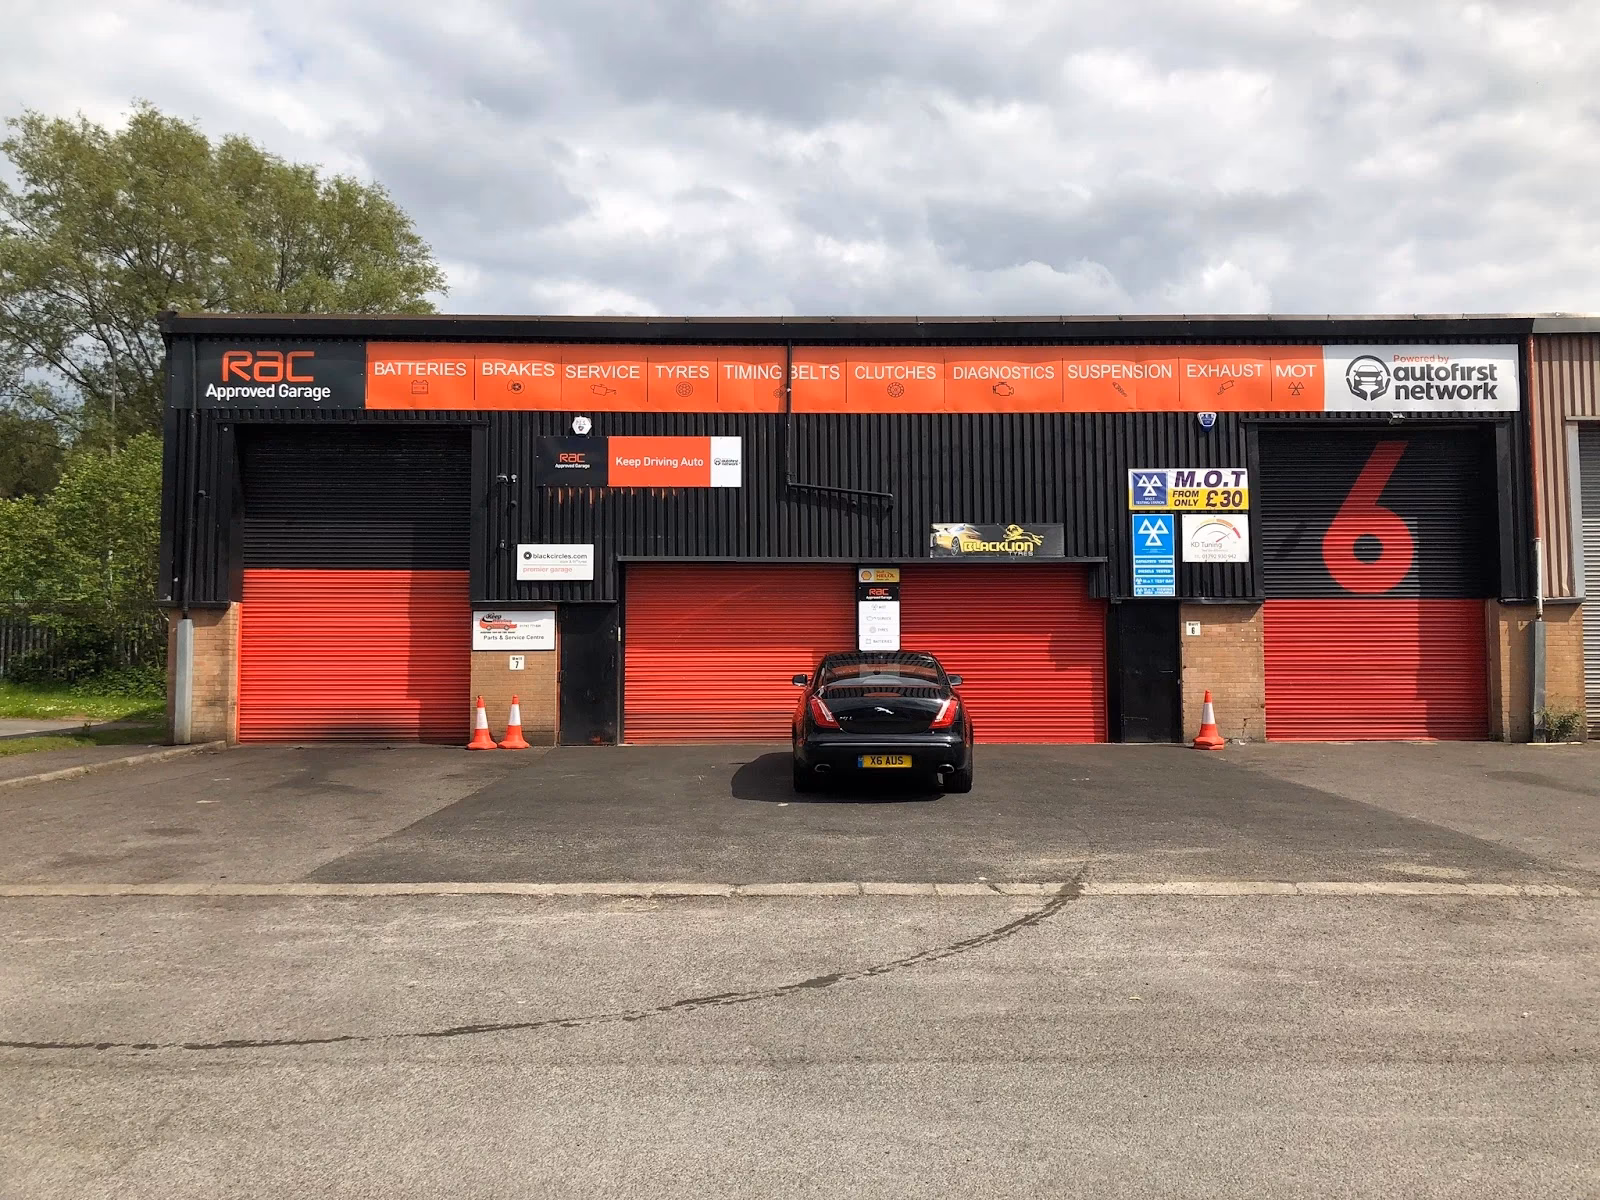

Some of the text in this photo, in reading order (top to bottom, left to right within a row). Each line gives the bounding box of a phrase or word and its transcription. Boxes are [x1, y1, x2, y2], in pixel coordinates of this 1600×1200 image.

[1393, 354, 1450, 364] Powered by
[374, 362, 467, 377] BATTERIES
[482, 362, 556, 377] BRAKES
[565, 364, 641, 379] SERVICE
[655, 365, 710, 379] TYRES
[724, 364, 841, 380] TIMING BELTS
[854, 365, 937, 380] CLUTCHES
[953, 366, 1055, 380] DIAGNOSTICS
[1067, 364, 1172, 379] SUSPENSION
[1186, 363, 1264, 378] EXHAUST
[1276, 364, 1317, 378] MOT
[1393, 363, 1498, 382] autofirst
[205, 384, 331, 401] Approved Garage
[1395, 382, 1498, 400] network
[616, 457, 704, 468] Keep Driving Auto
[1174, 470, 1246, 488] M.O.T
[1206, 490, 1243, 508] £30
[1322, 441, 1415, 594] 6
[870, 756, 904, 765] X6 AUS
